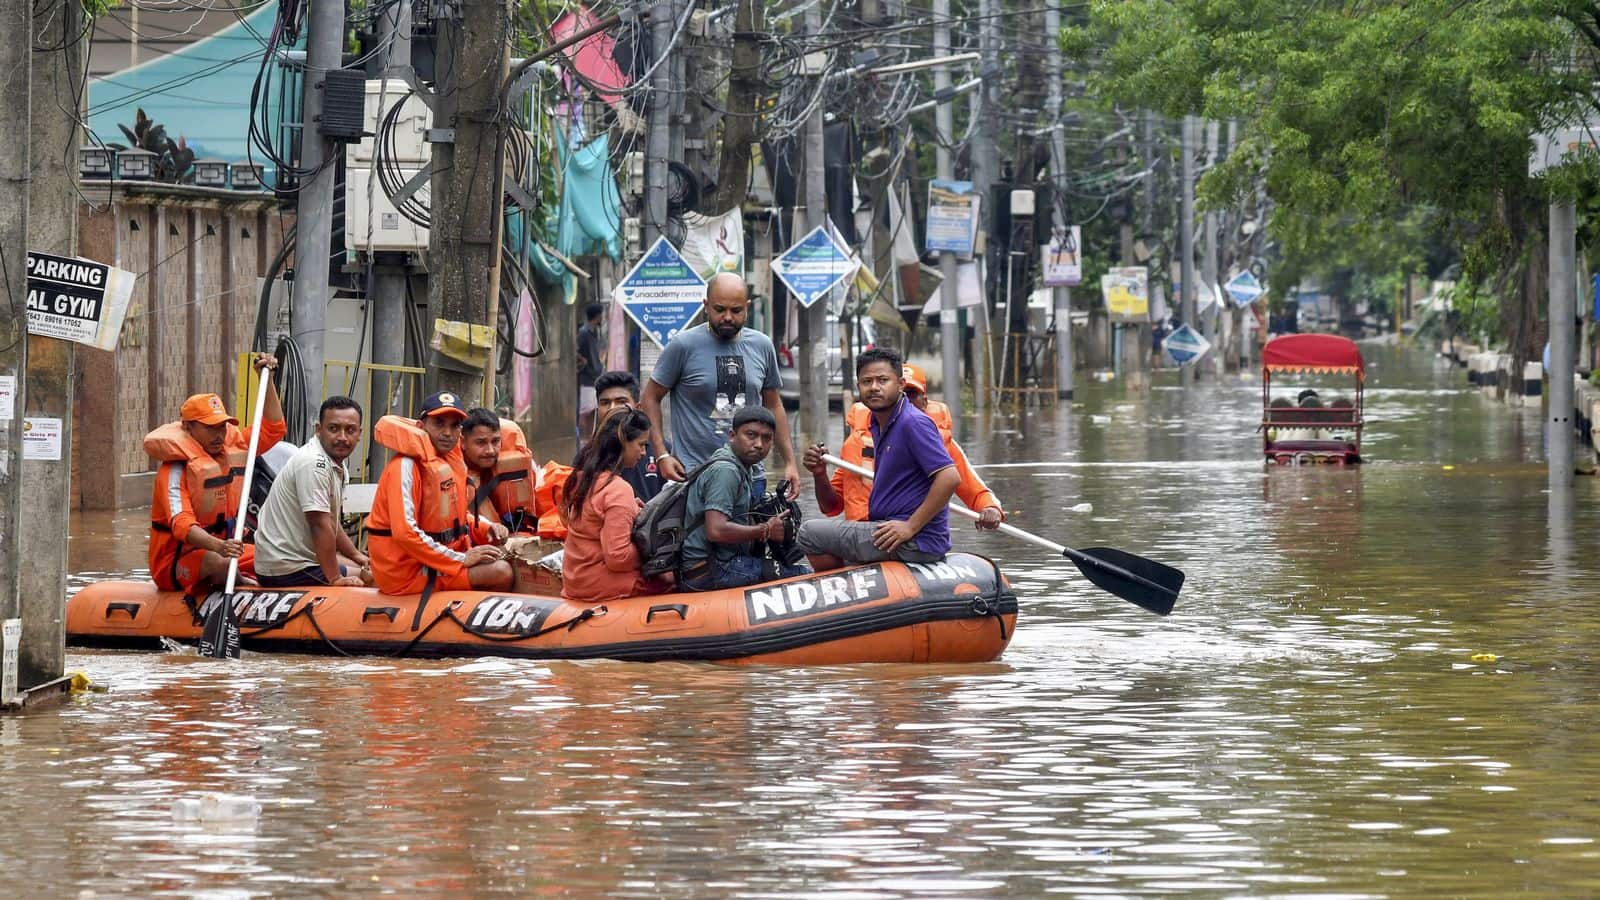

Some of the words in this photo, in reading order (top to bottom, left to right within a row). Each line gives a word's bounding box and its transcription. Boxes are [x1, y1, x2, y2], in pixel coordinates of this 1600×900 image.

[27, 257, 102, 285] PARKING
[54, 294, 96, 319] GYM
[635, 291, 680, 299] unacademy
[750, 567, 878, 620] NDRF
